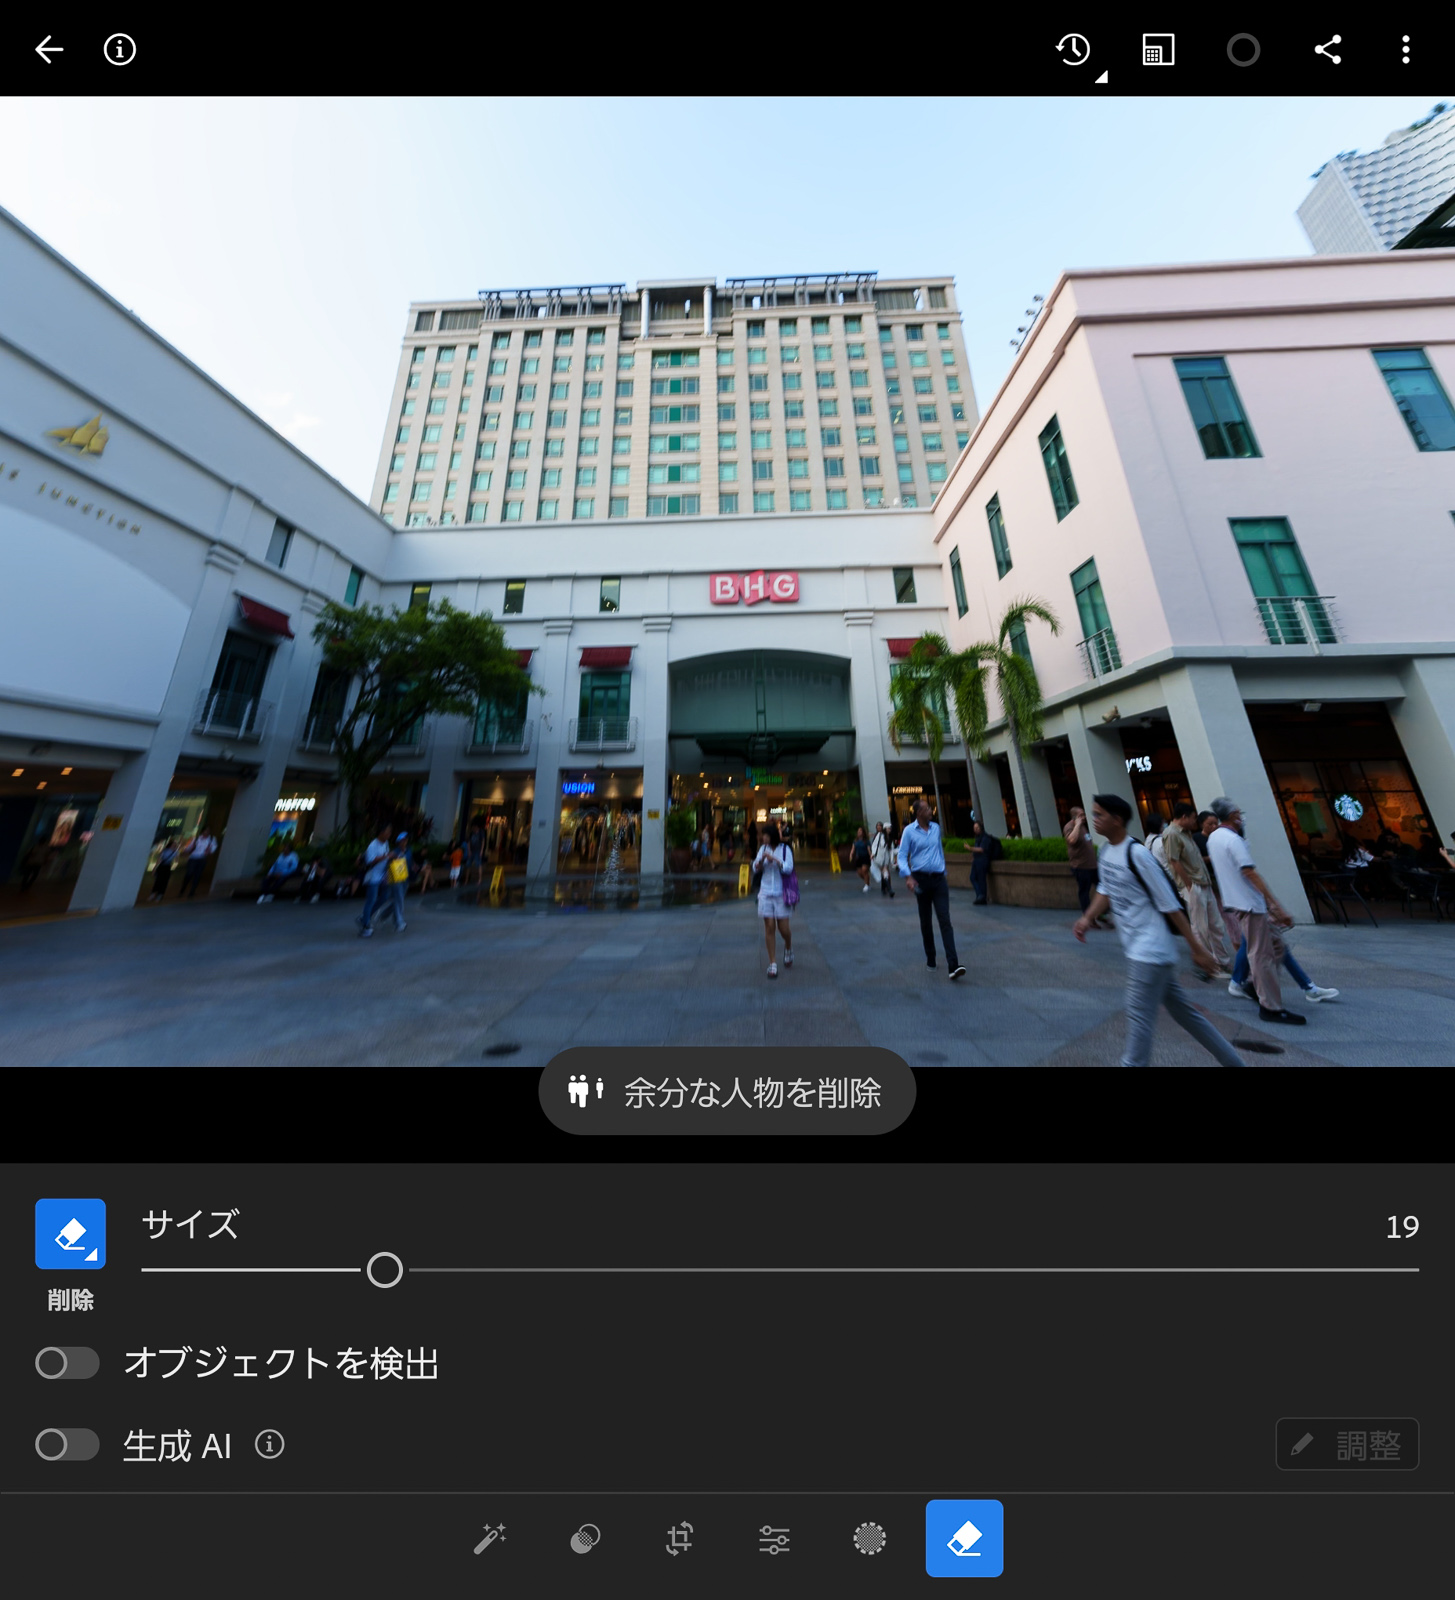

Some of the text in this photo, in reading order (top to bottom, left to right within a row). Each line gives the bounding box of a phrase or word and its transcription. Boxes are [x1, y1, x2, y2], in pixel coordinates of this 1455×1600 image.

[38, 481, 142, 535] JUNCTION
[715, 574, 796, 600] BHG
[624, 1076, 882, 1109] 余分な人物を削除
[141, 1207, 241, 1240] サイズ
[1386, 1215, 1420, 1239] 19
[47, 1287, 95, 1312] 削除
[124, 1345, 439, 1381] オブジェクトを検出
[122, 1428, 232, 1463] 生成 AI
[1336, 1429, 1402, 1462] 調整
